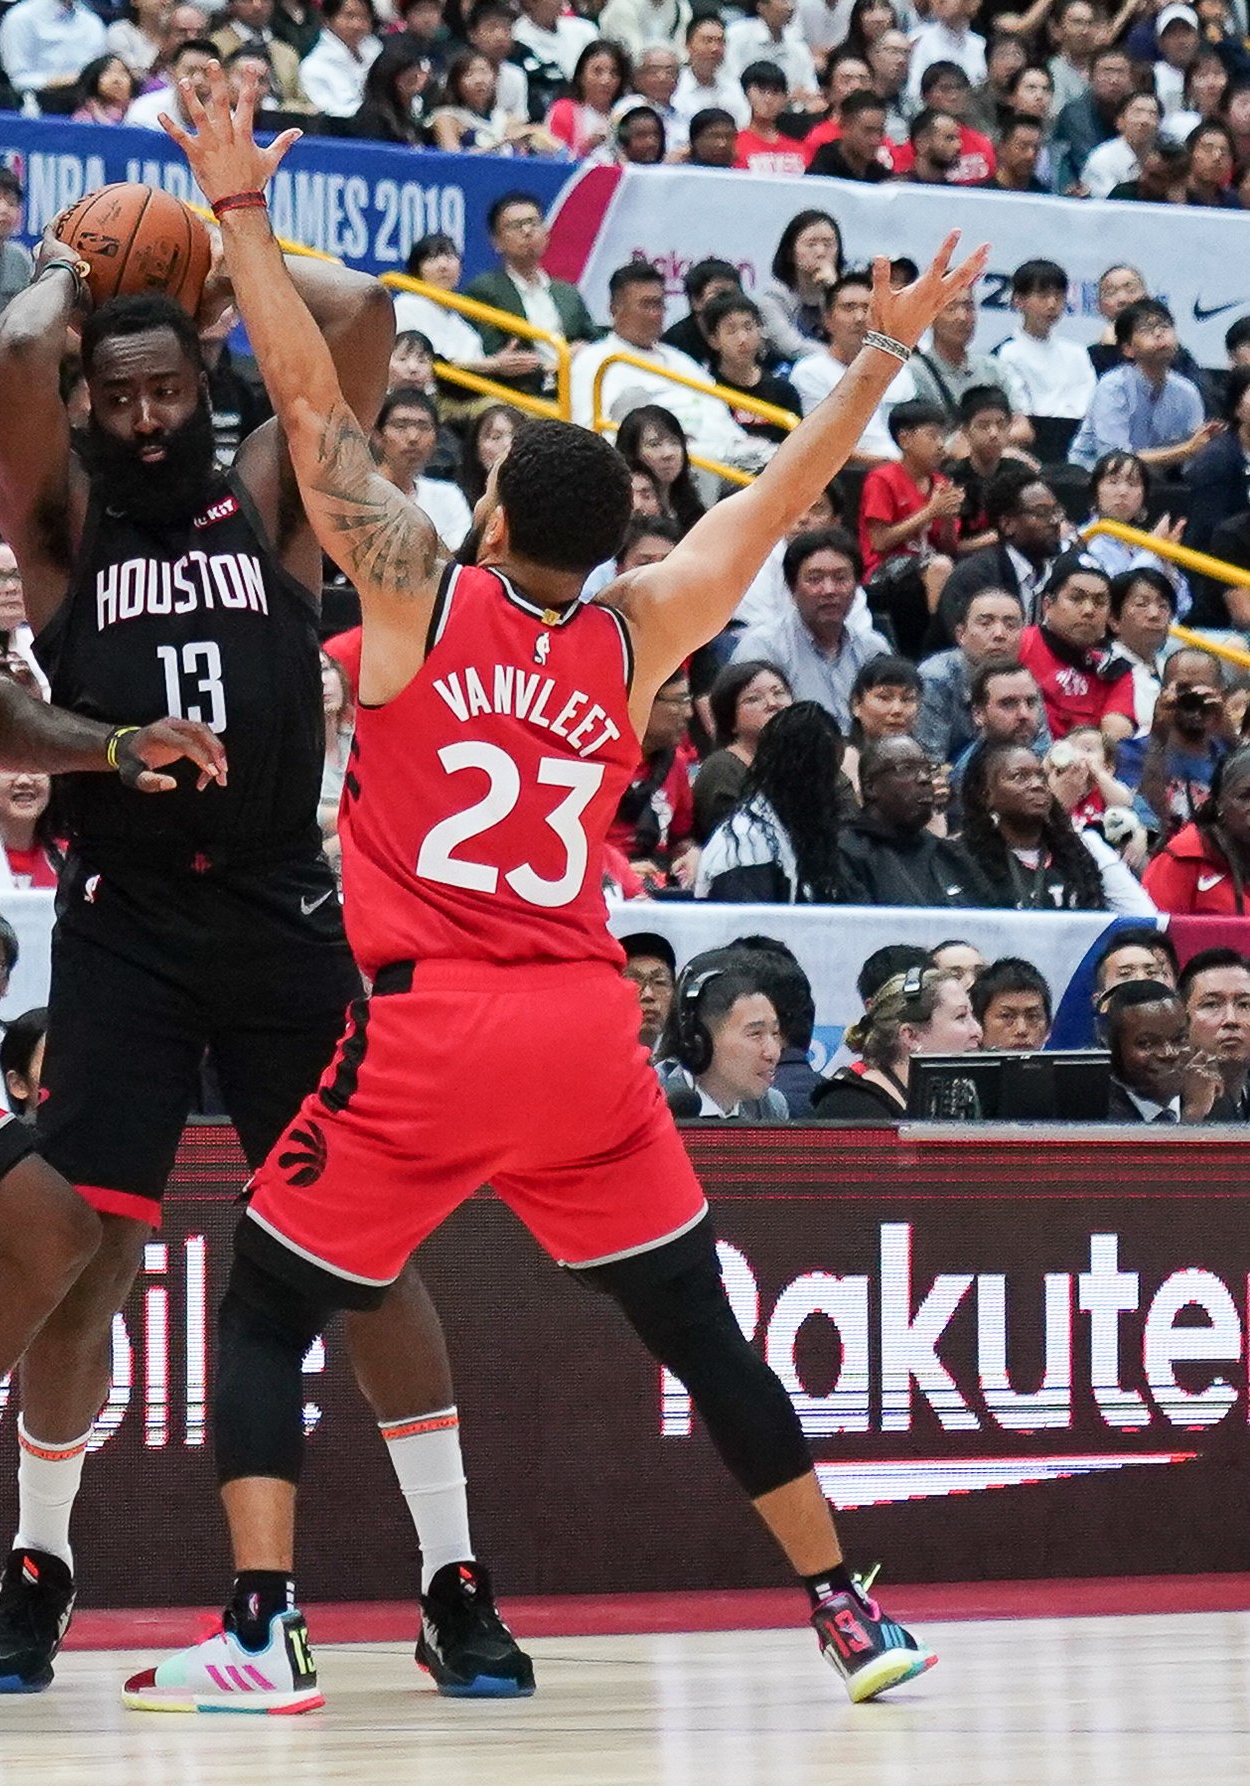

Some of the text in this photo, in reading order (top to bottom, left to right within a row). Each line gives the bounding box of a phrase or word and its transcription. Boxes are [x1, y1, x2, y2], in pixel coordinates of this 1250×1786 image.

[265, 168, 370, 260] AMES
[96, 550, 269, 632] HOUSTON
[156, 640, 228, 735] 13
[432, 664, 621, 758] VANVLEET
[415, 740, 606, 908] 23
